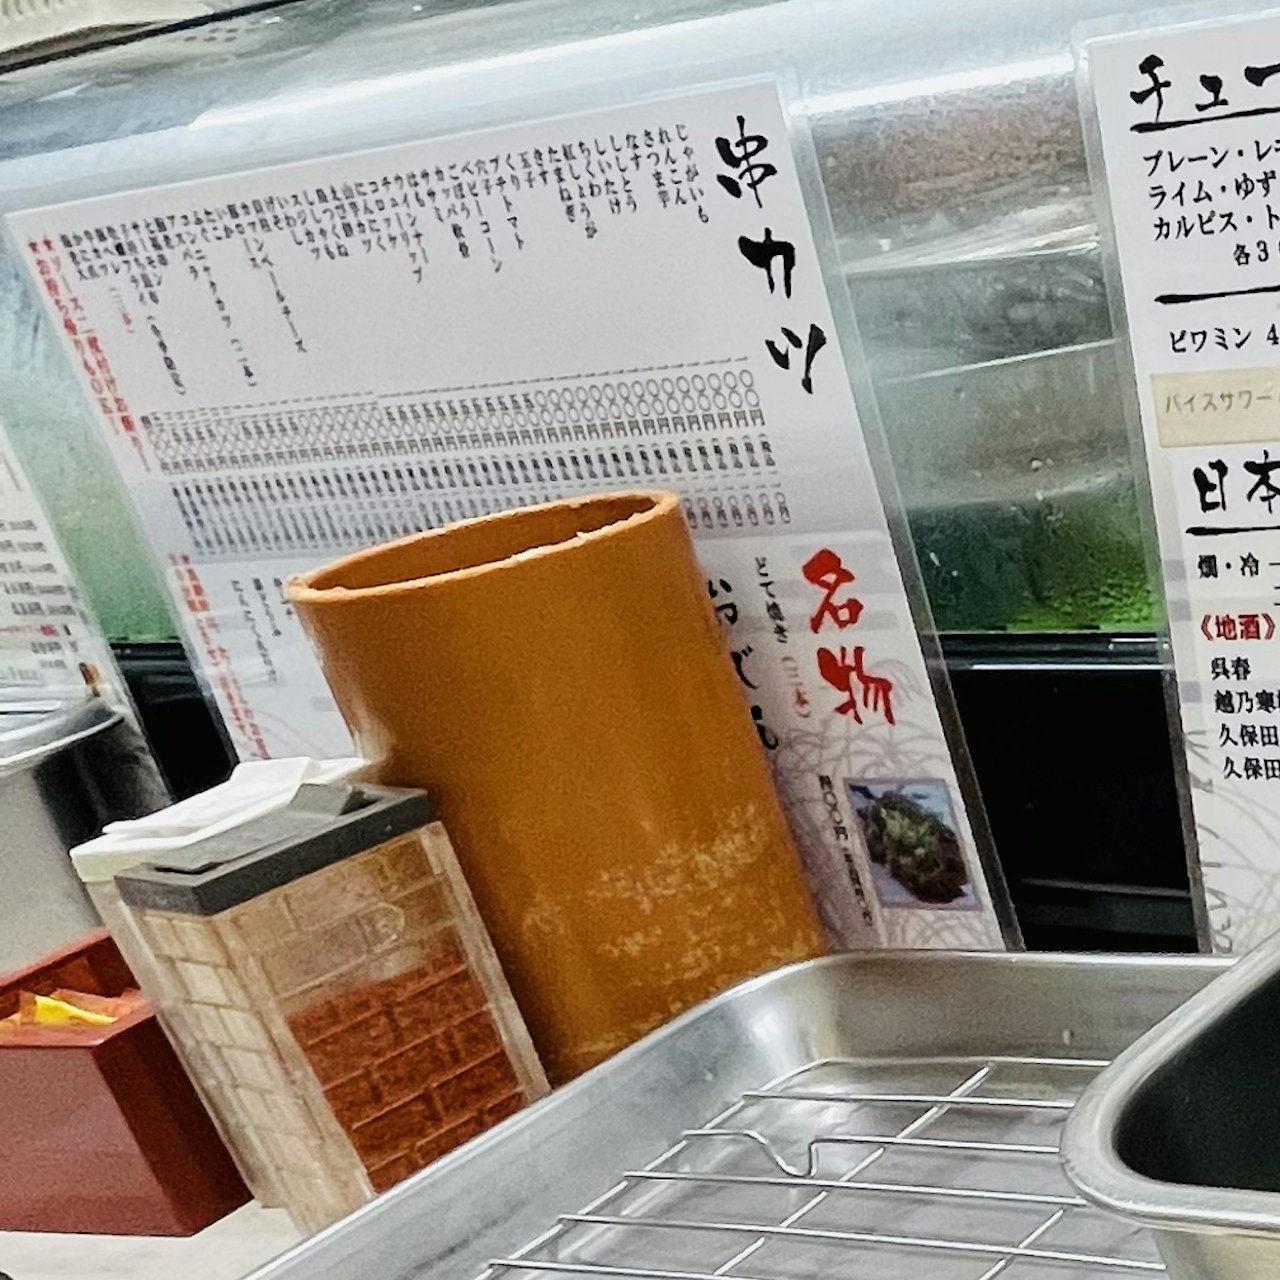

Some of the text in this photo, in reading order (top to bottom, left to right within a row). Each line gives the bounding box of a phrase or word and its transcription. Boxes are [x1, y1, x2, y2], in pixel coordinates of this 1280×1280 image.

[594, 138, 621, 215] しいたけ
[610, 135, 637, 213] ししとう
[659, 127, 687, 205] れんこん
[676, 123, 709, 223] じゃがいも
[1147, 169, 1278, 211] ライム・ゆず
[715, 114, 828, 395] 串カツ
[803, 548, 895, 726] 名物
[1219, 723, 1279, 748] 久保田
